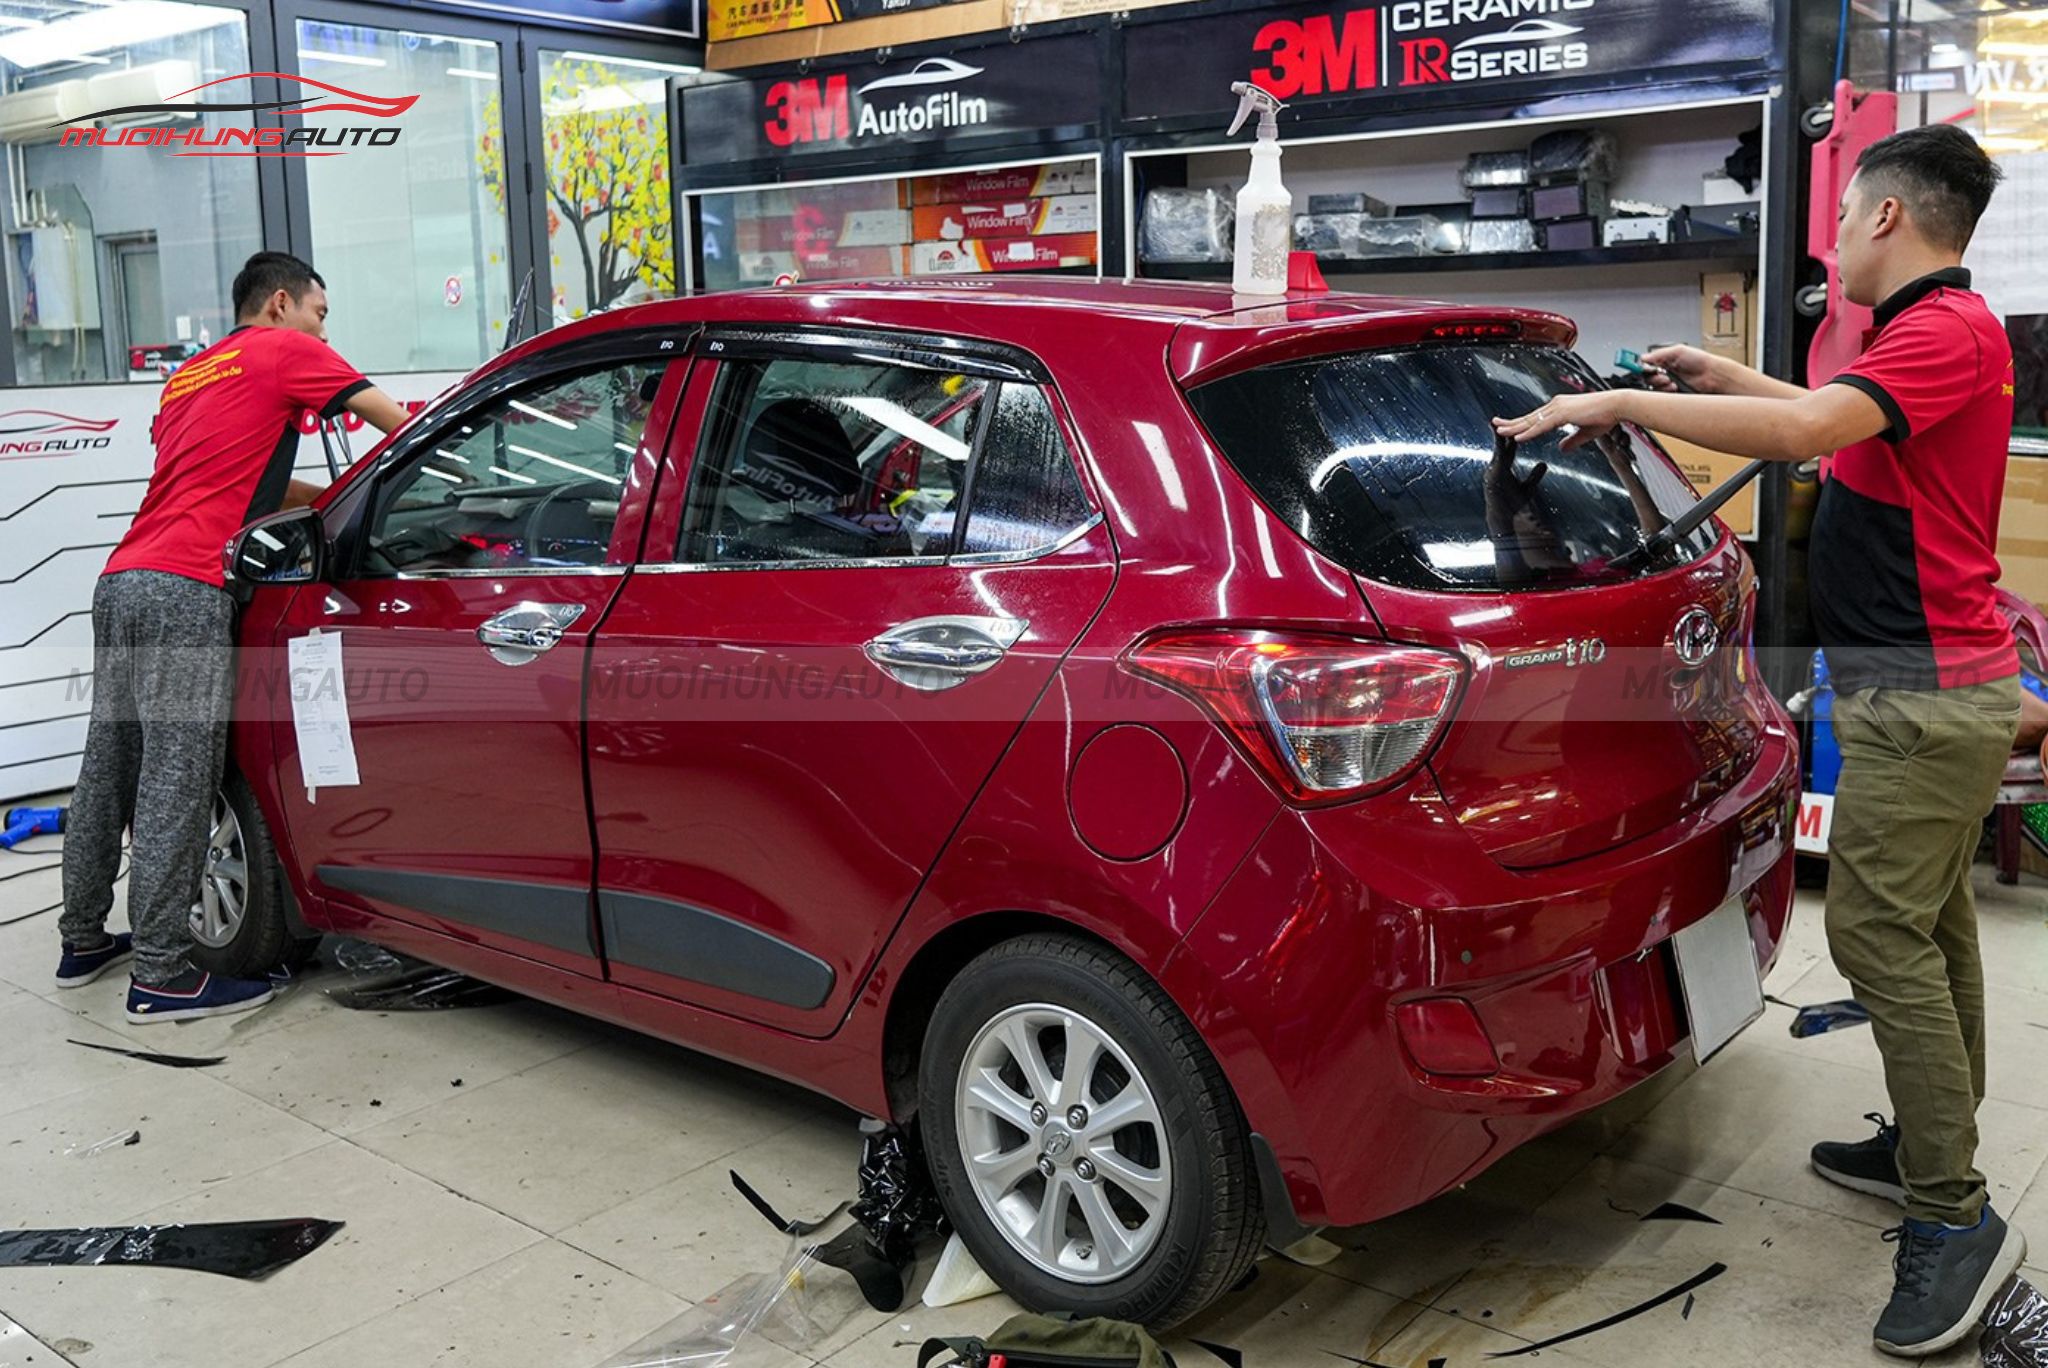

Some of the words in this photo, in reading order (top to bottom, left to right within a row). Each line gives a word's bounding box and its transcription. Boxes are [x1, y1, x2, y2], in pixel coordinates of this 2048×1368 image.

[1250, 8, 1377, 100] 3M
[1450, 42, 1589, 82] SERIES
[765, 74, 848, 146] 3M
[856, 91, 988, 138] AutoFilm
[966, 176, 1005, 191] Window
[1007, 174, 1030, 189] Film
[966, 216, 1008, 230] Window
[1036, 247, 1058, 262] Film
[1509, 651, 1562, 667] GRAND
[1565, 638, 1605, 667] i10
